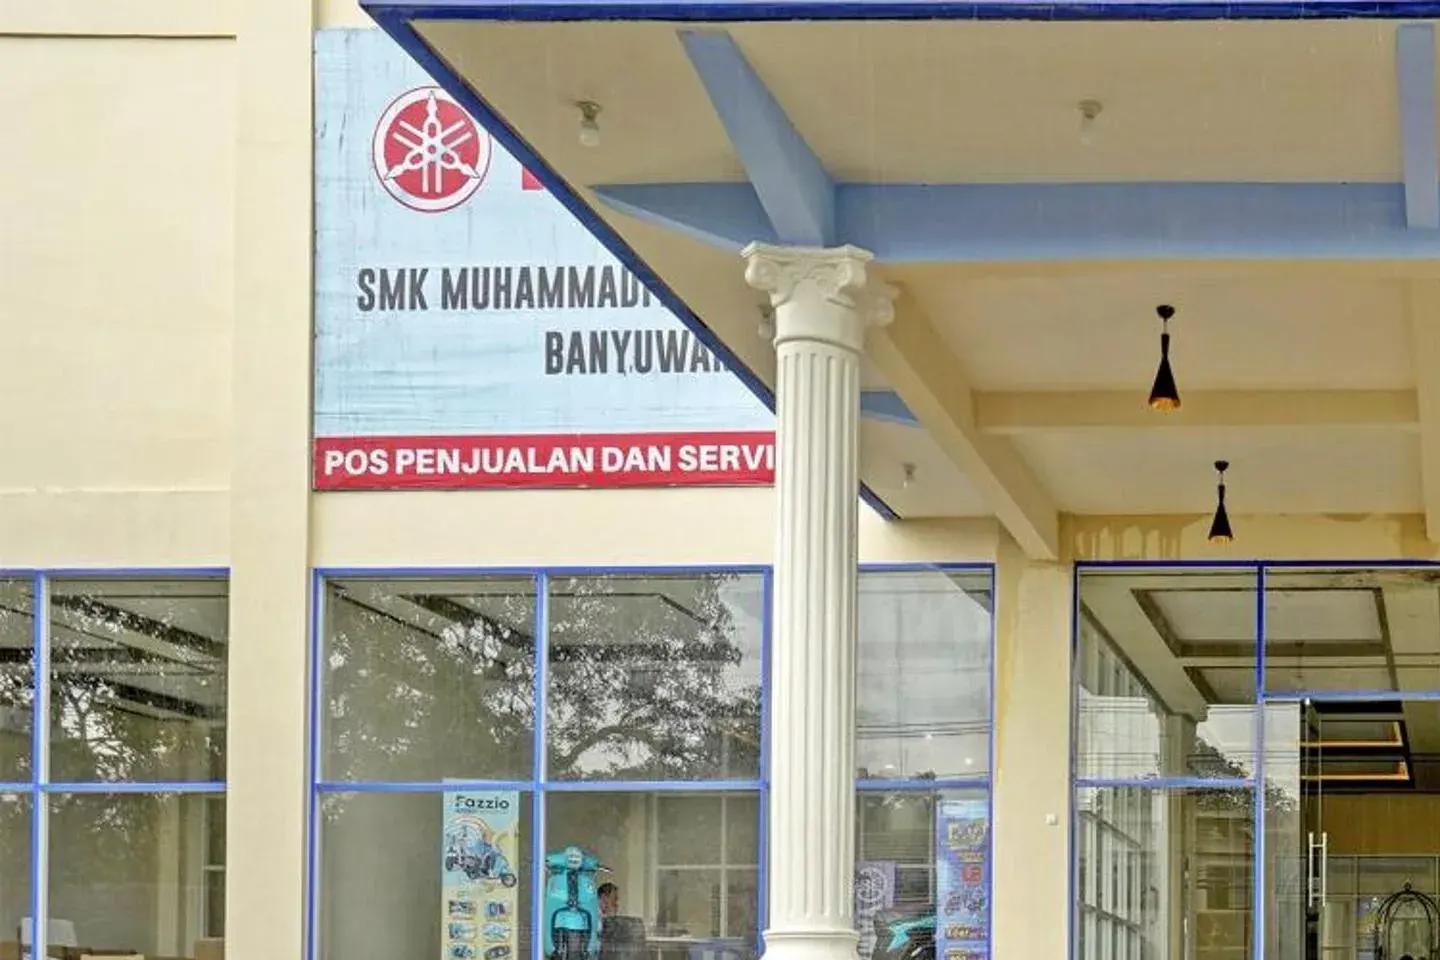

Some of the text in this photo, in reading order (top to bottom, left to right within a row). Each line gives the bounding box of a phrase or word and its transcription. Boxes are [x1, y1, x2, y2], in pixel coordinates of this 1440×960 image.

[357, 264, 665, 312] SMK MUHAMMADI
[324, 450, 389, 475] POS
[395, 447, 594, 475] PENJUALAN
[601, 447, 672, 472] DAN
